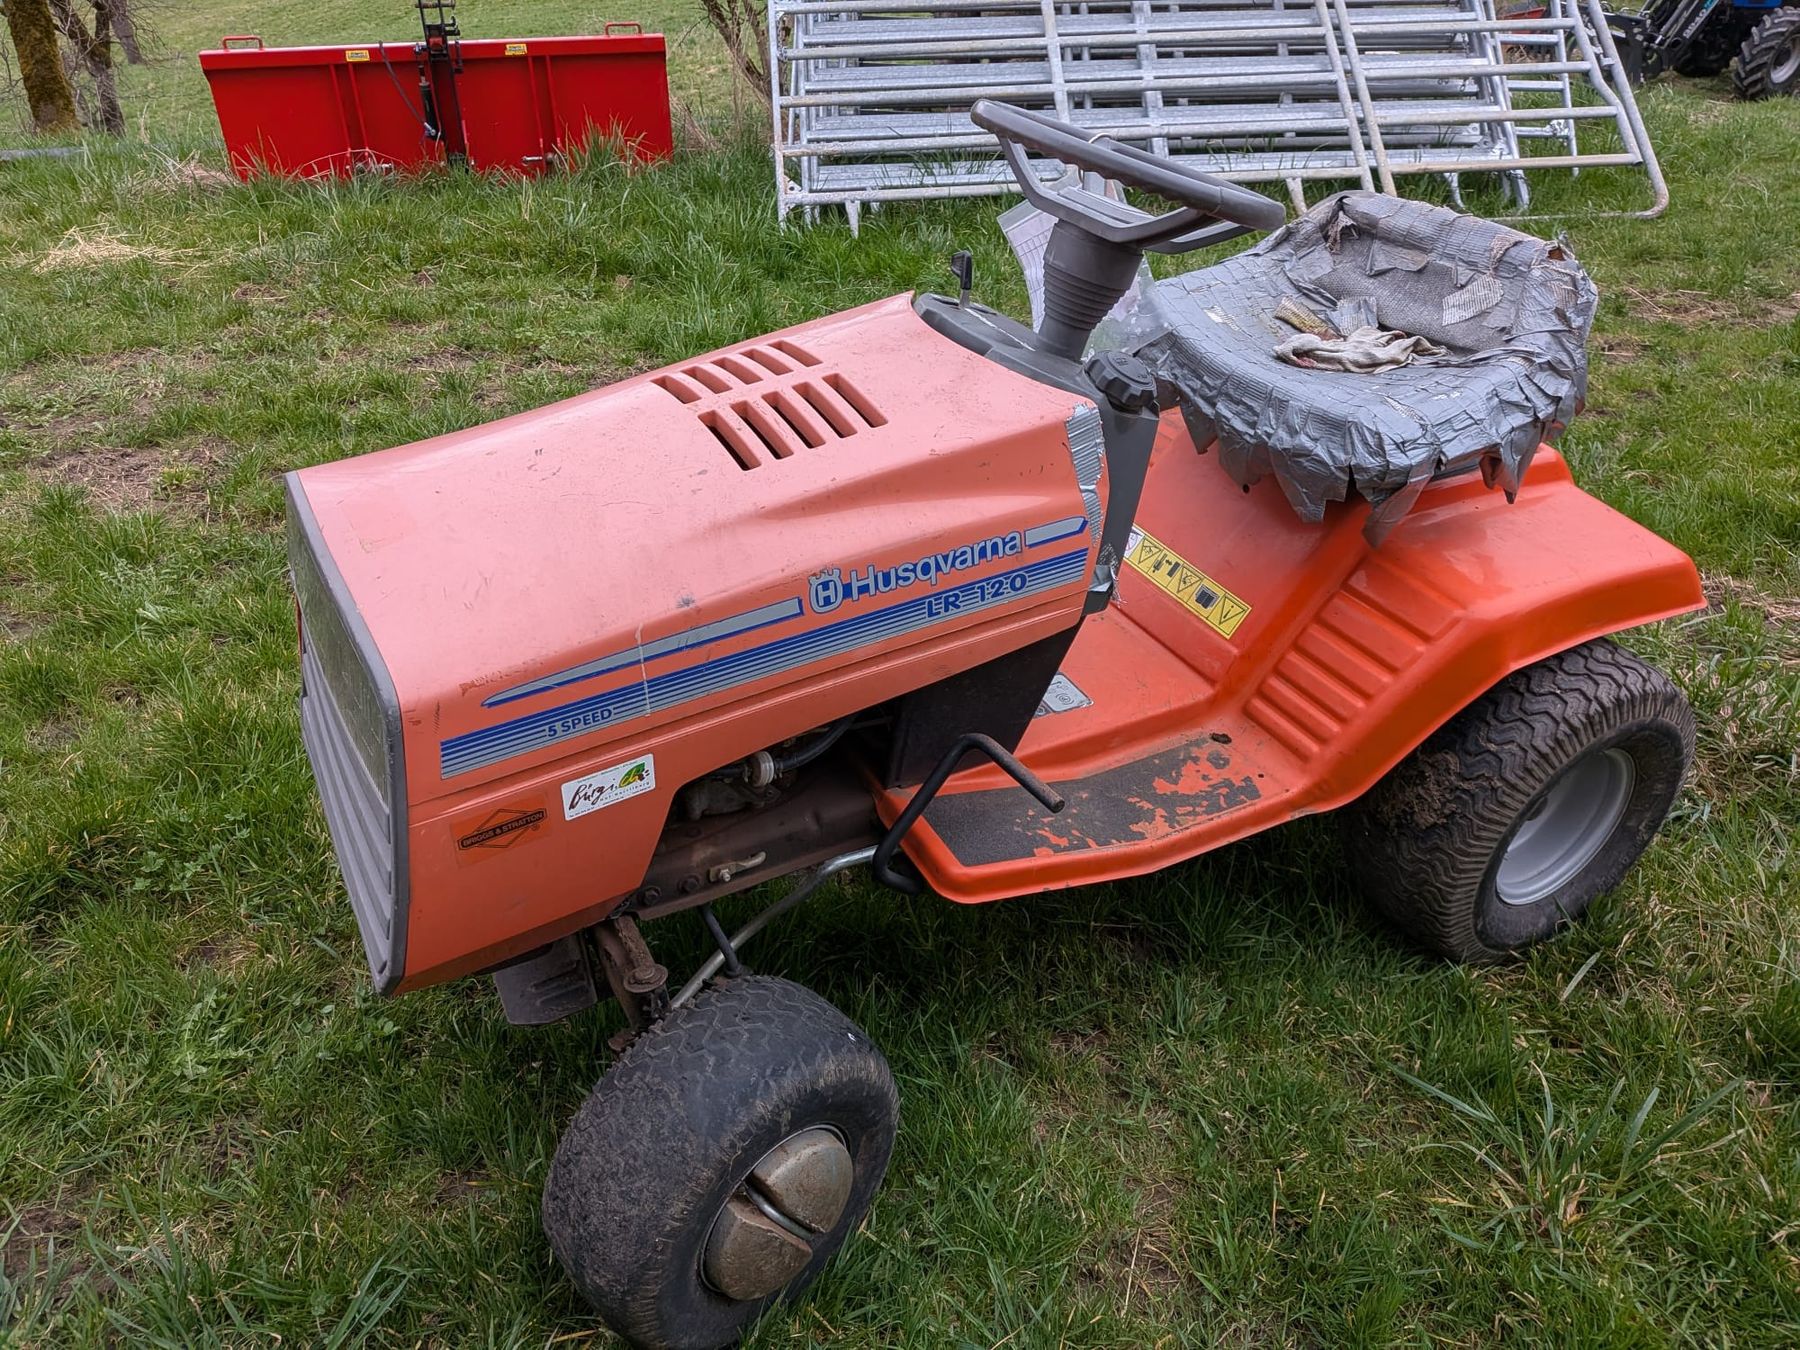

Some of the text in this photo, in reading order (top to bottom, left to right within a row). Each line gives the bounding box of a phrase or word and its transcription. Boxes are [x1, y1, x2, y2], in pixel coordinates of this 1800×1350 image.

[851, 531, 1023, 602] Husqvarna
[926, 573, 1028, 618] LR 120
[547, 708, 613, 737] 5 SPEED
[462, 830, 495, 849] BRIGGS
[502, 812, 543, 833] STRATTON
